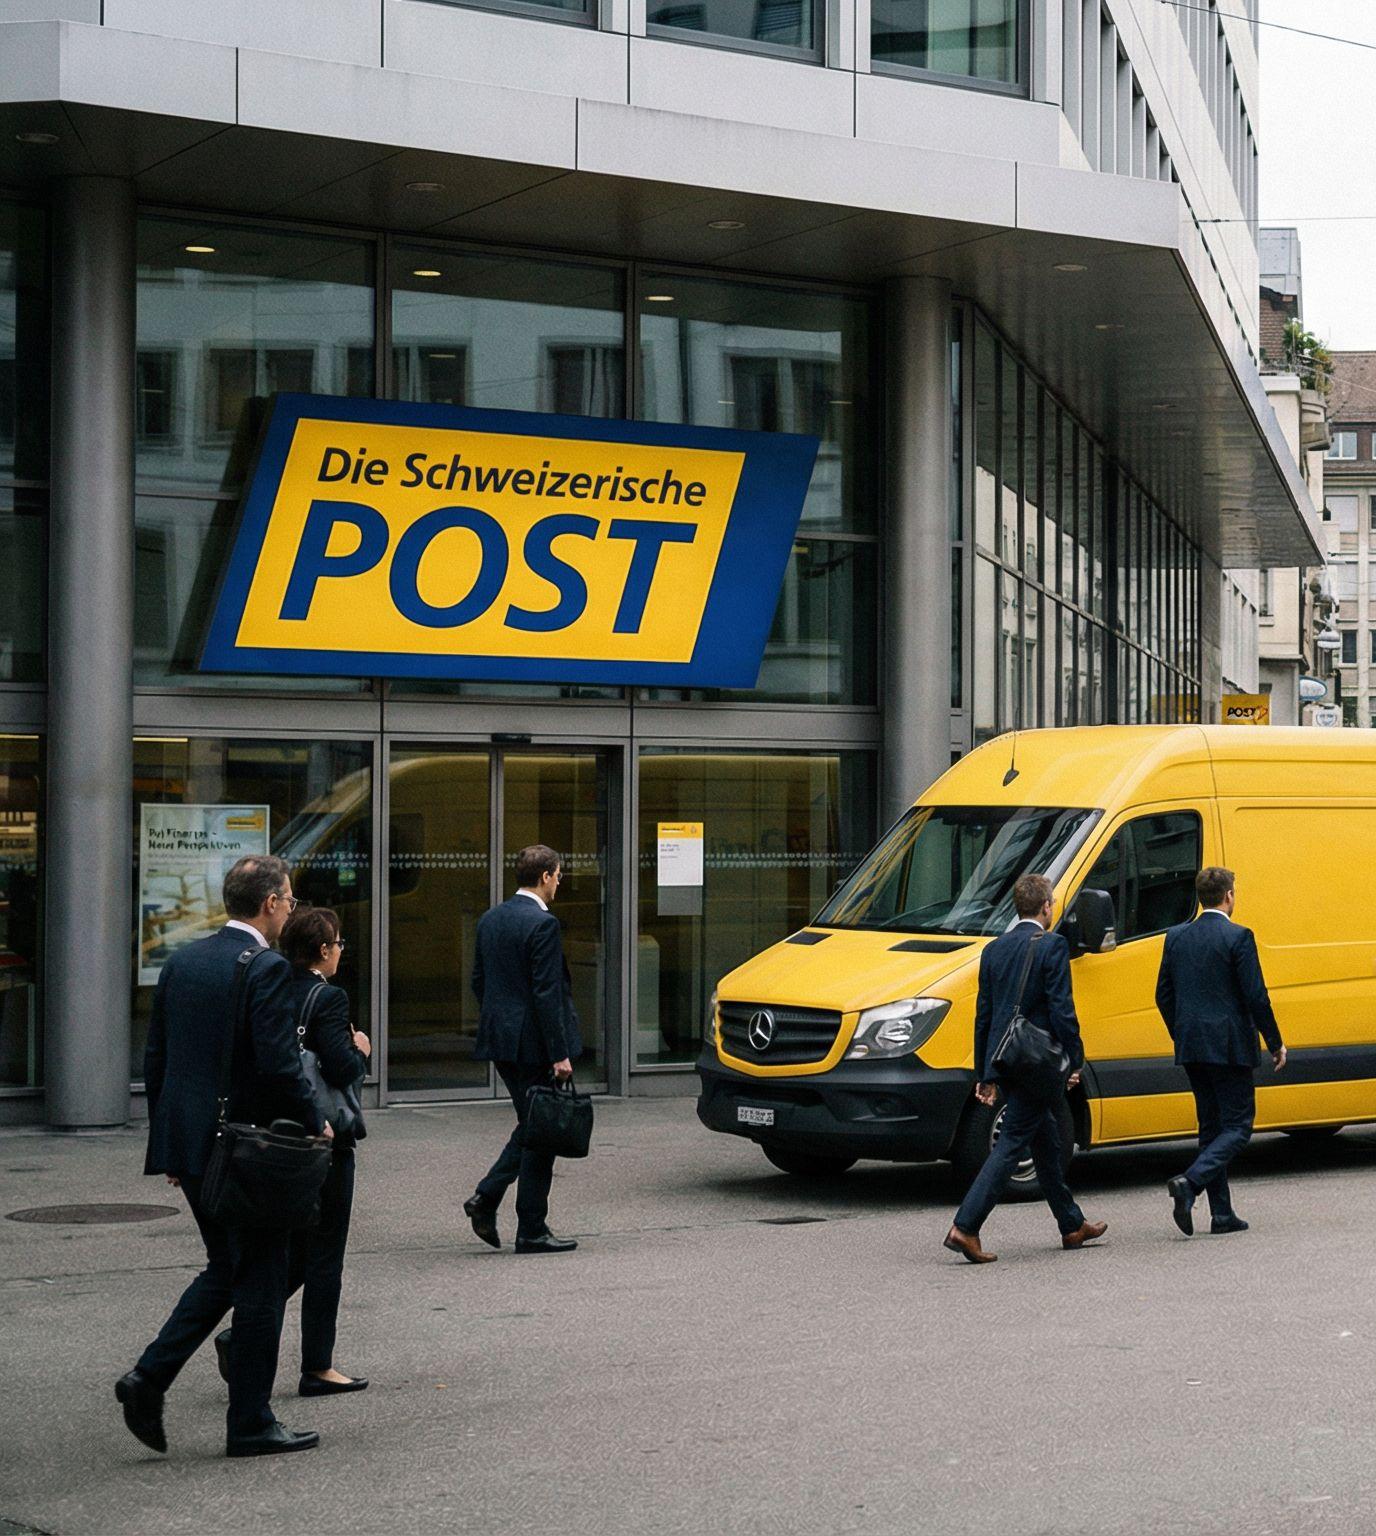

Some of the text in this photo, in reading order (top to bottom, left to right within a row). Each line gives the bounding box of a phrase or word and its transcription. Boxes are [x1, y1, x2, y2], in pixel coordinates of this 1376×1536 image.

[317, 446, 707, 507] Die Schweizerische
[279, 499, 699, 634] POST
